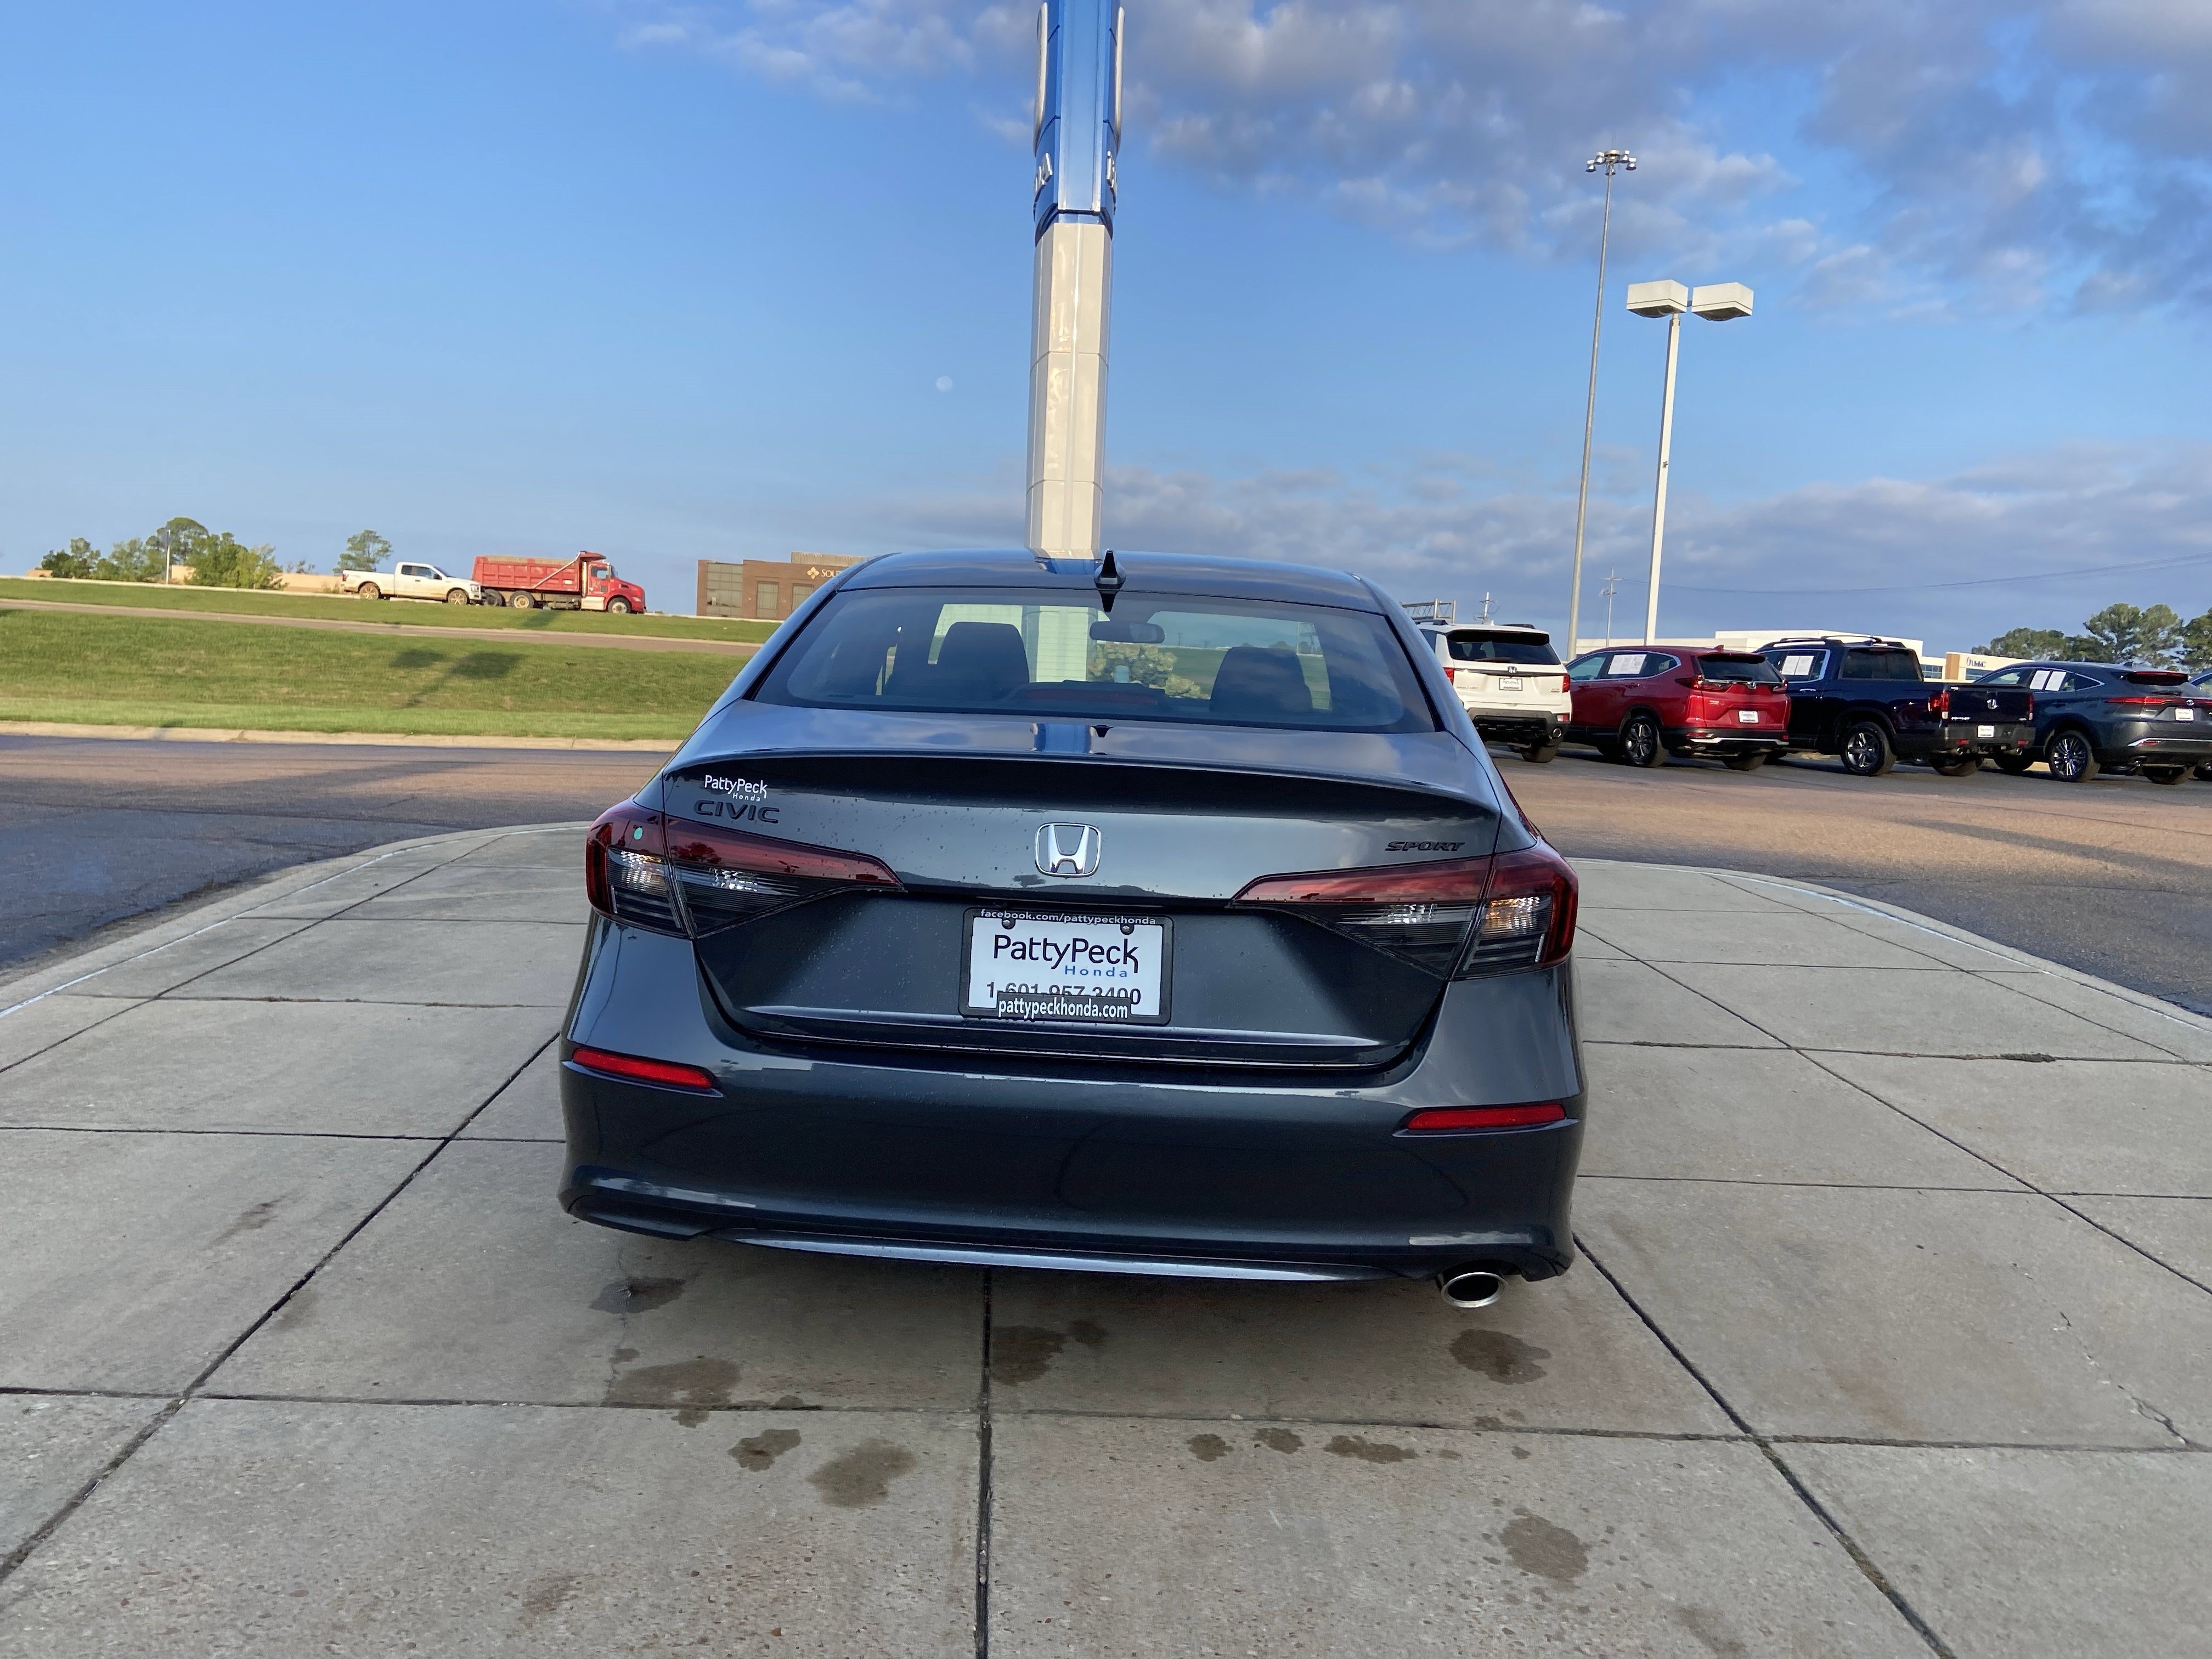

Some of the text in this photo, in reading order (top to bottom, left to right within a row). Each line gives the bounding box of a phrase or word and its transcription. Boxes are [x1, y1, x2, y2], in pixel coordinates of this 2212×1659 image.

[821, 569, 842, 577] SOU
[704, 775, 768, 799] PattyPeck
[733, 793, 760, 802] Honda
[694, 800, 780, 823] CIVIC
[1384, 841, 1465, 851] SPORT
[980, 909, 1156, 924] facebook.com/pattypeckhonda
[994, 934, 1139, 973] PattyPeck
[1065, 966, 1127, 977] Honda
[998, 997, 1128, 1019] pattypeckhonda.com
